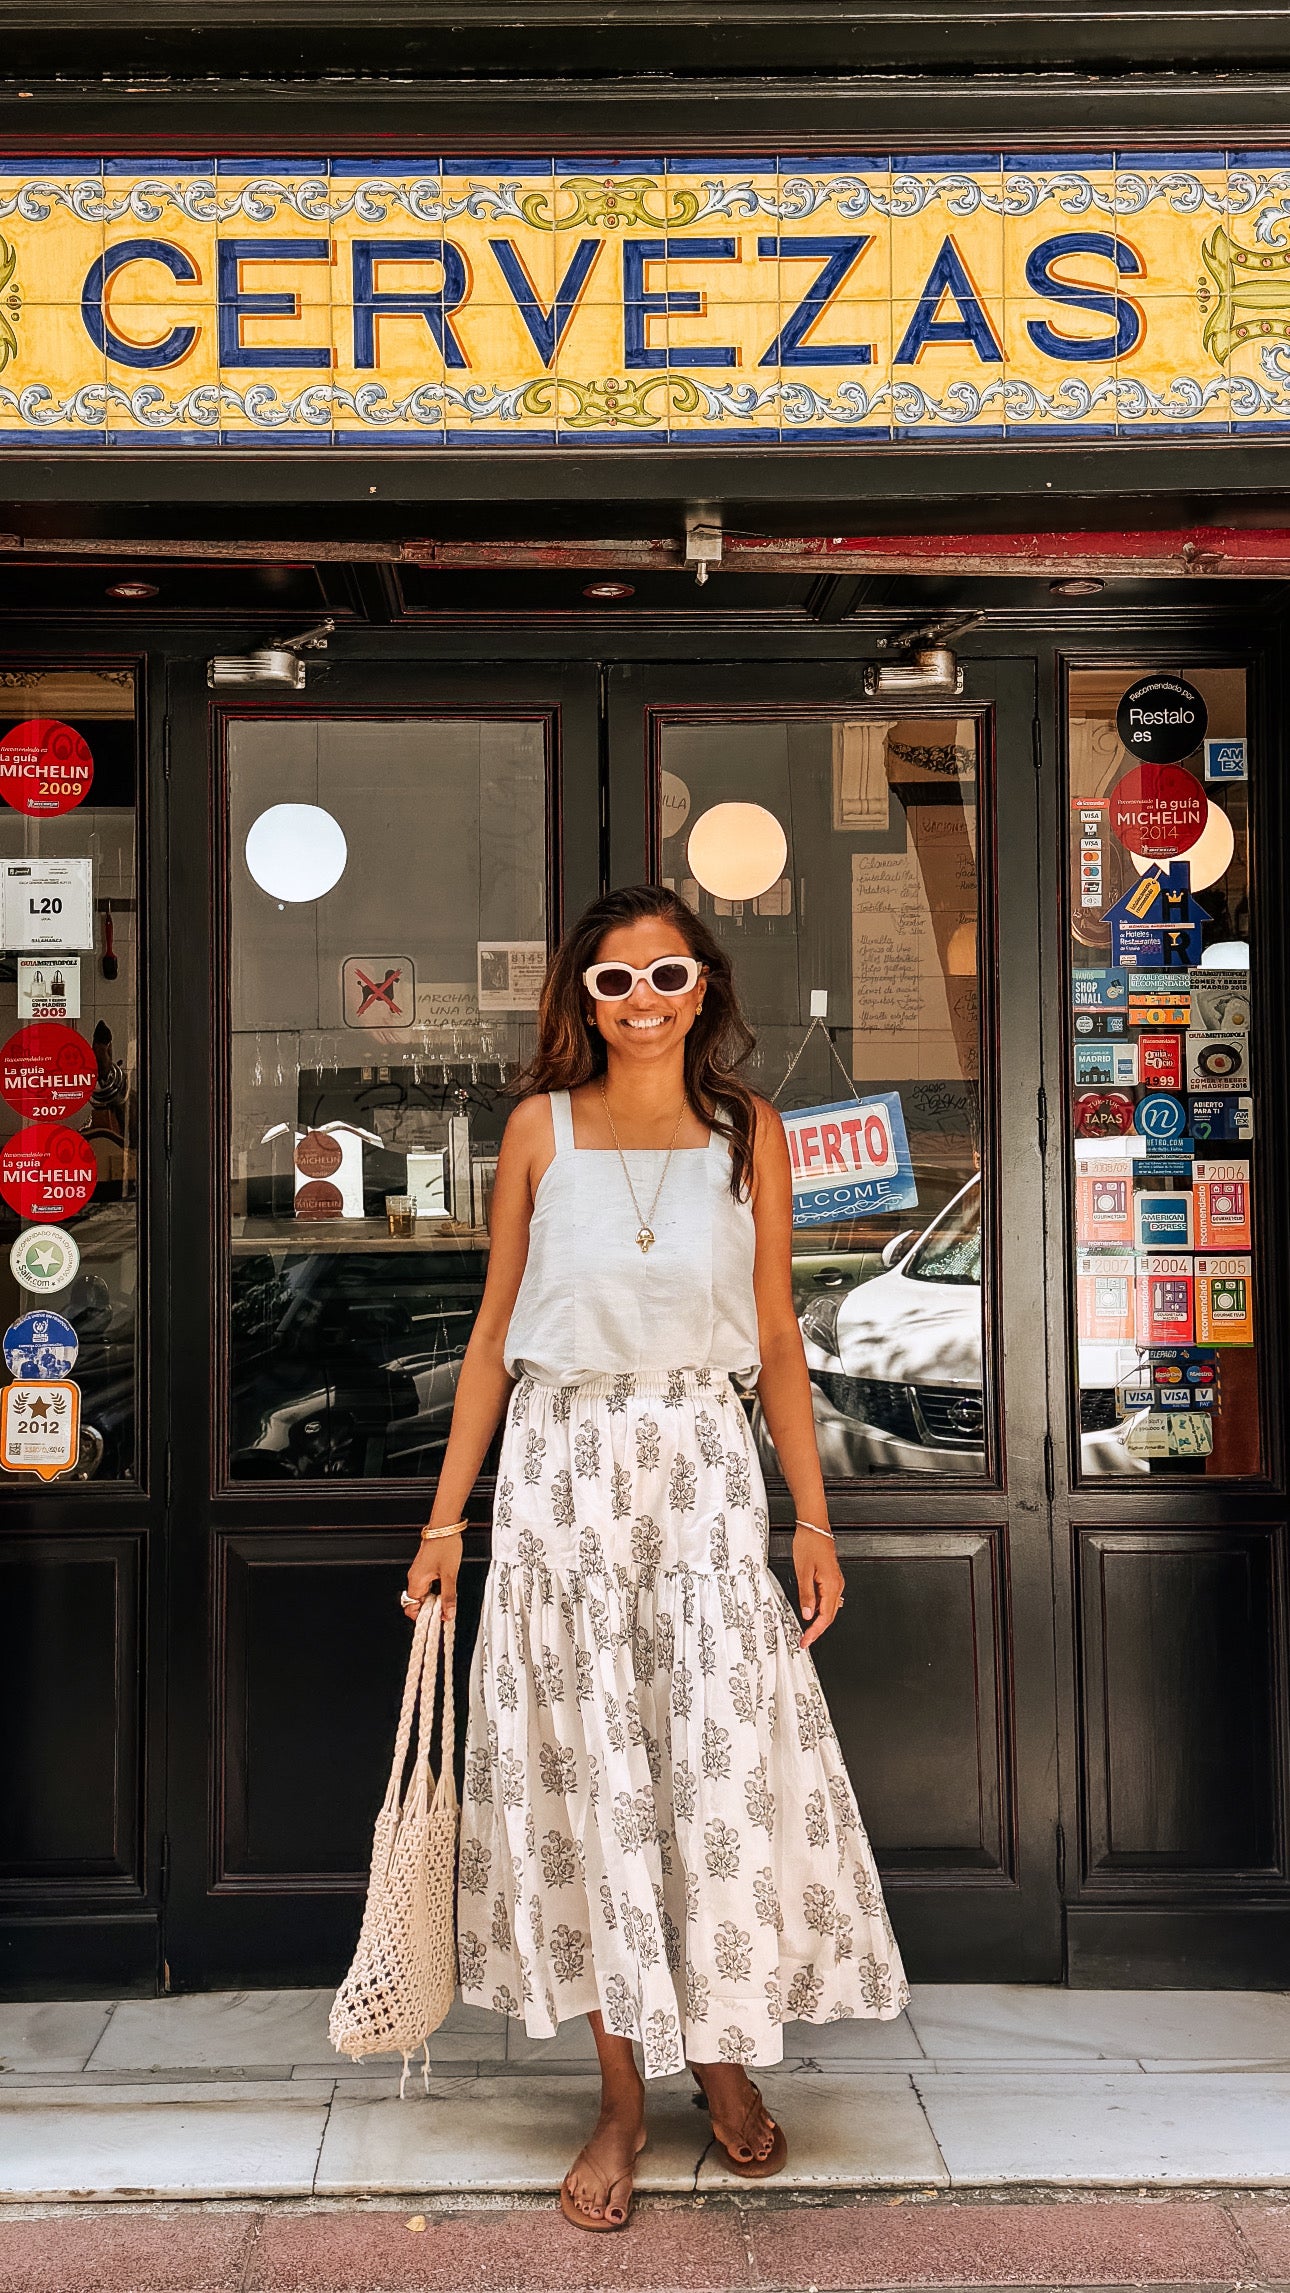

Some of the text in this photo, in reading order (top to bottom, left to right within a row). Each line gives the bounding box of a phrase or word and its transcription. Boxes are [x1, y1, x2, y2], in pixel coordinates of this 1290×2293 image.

[81, 231, 1147, 371] CERVEZAS
[1128, 681, 1195, 702] Recomendado por
[1130, 707, 1194, 726] Restalo
[1130, 731, 1152, 743] .es
[0, 754, 38, 763] La guía
[1217, 748, 1243, 761] AM
[0, 765, 89, 779] MICHELIN
[1221, 760, 1244, 772] EX
[39, 782, 82, 796] 2009
[1156, 797, 1200, 810] la guía
[1117, 811, 1200, 825] MICHELIN
[1140, 826, 1179, 840] 2014
[29, 898, 63, 914] L20
[1075, 981, 1098, 993] SHOP
[1131, 980, 1190, 988] RECOMENDADO
[1075, 993, 1103, 1004] SMALL
[31, 1007, 67, 1017] 2009
[430, 1006, 460, 1015] UNA
[1078, 1055, 1111, 1063] MADRID
[4, 1066, 45, 1077] La guía
[4, 1074, 92, 1090] MICHELIN
[1145, 1076, 1175, 1087] 1999
[32, 1106, 66, 1117] 2007
[1084, 1113, 1123, 1124] TAPAS
[3, 1159, 41, 1169] La guía
[3, 1169, 92, 1183] MICHELIN
[1208, 1166, 1245, 1180] 2006
[42, 1186, 87, 1199] 2008
[793, 1181, 892, 1210] LCOME
[1198, 1186, 1208, 1246] recomendado
[1095, 1260, 1129, 1273] 2007
[1152, 1258, 1188, 1273] 2004
[1210, 1261, 1246, 1275] 2005
[18, 1264, 50, 1287] Salir.com
[1141, 1279, 1150, 1338] recomendado
[1199, 1279, 1209, 1341] recomendado
[1129, 1392, 1154, 1402] VISA
[1164, 1392, 1189, 1402] VISA
[1199, 1390, 1209, 1400] V
[17, 1421, 60, 1434] 2012
